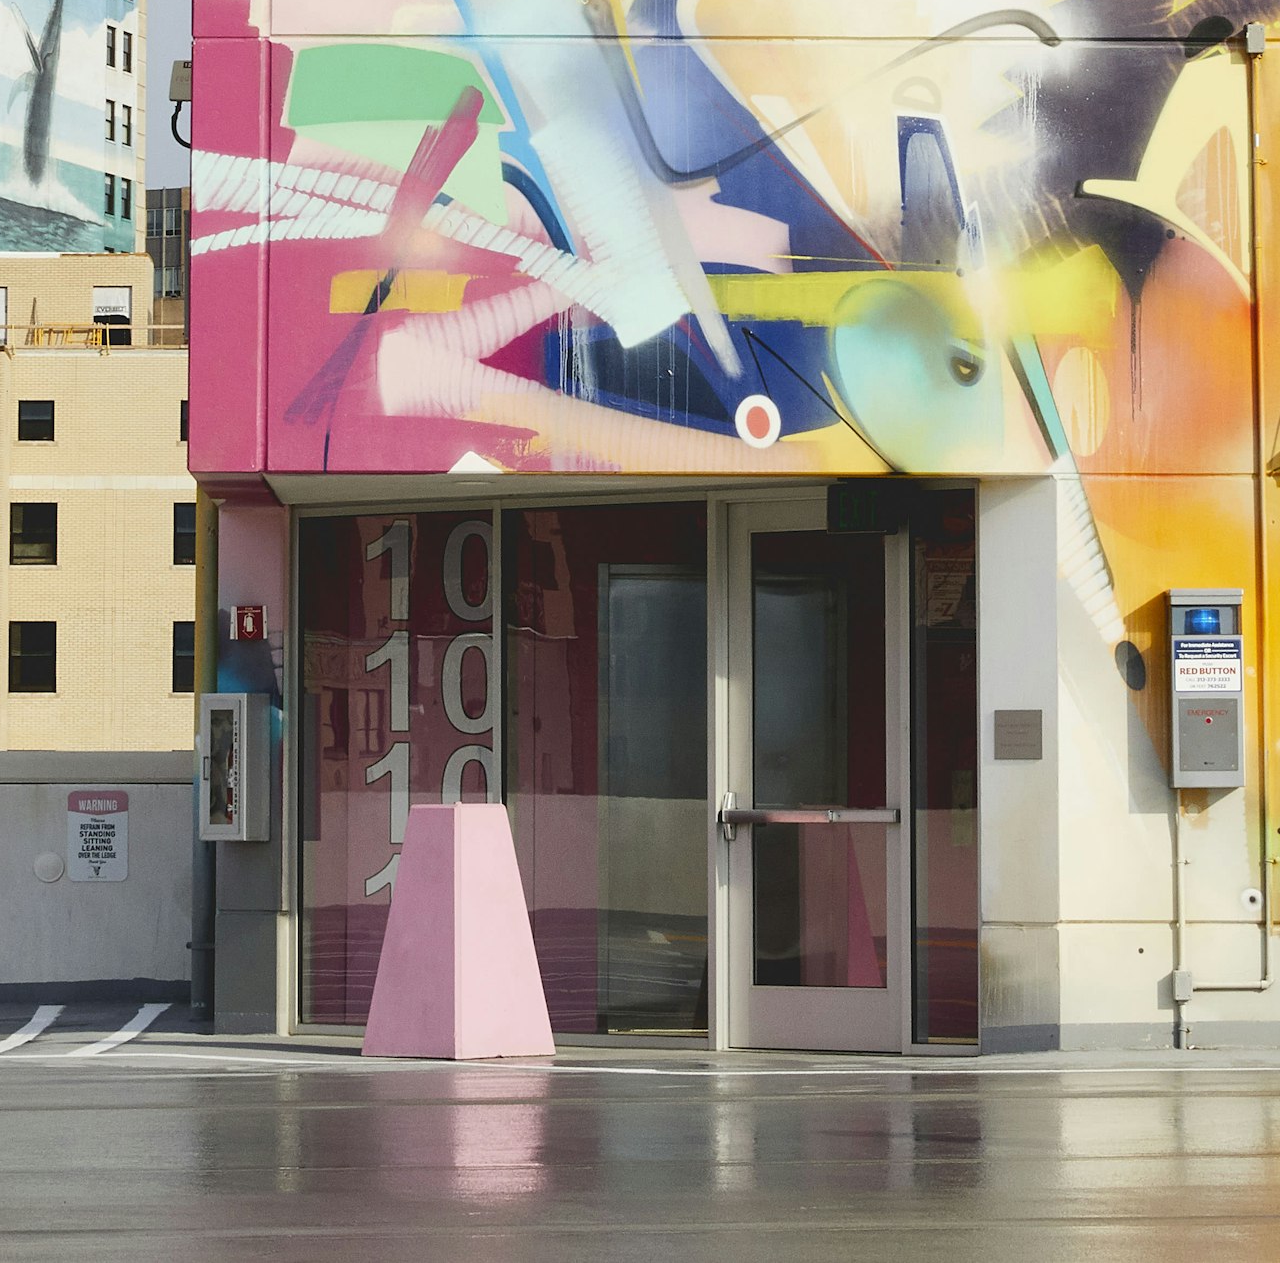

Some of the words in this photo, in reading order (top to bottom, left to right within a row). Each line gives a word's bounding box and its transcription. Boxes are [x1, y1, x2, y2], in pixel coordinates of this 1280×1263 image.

[839, 490, 879, 529] EXIT
[364, 518, 494, 622] 10
[364, 629, 494, 735] 10
[1179, 667, 1198, 675] RED
[1199, 667, 1237, 675] BUTTON
[78, 799, 118, 811] WARNING
[79, 830, 116, 838] STANDING
